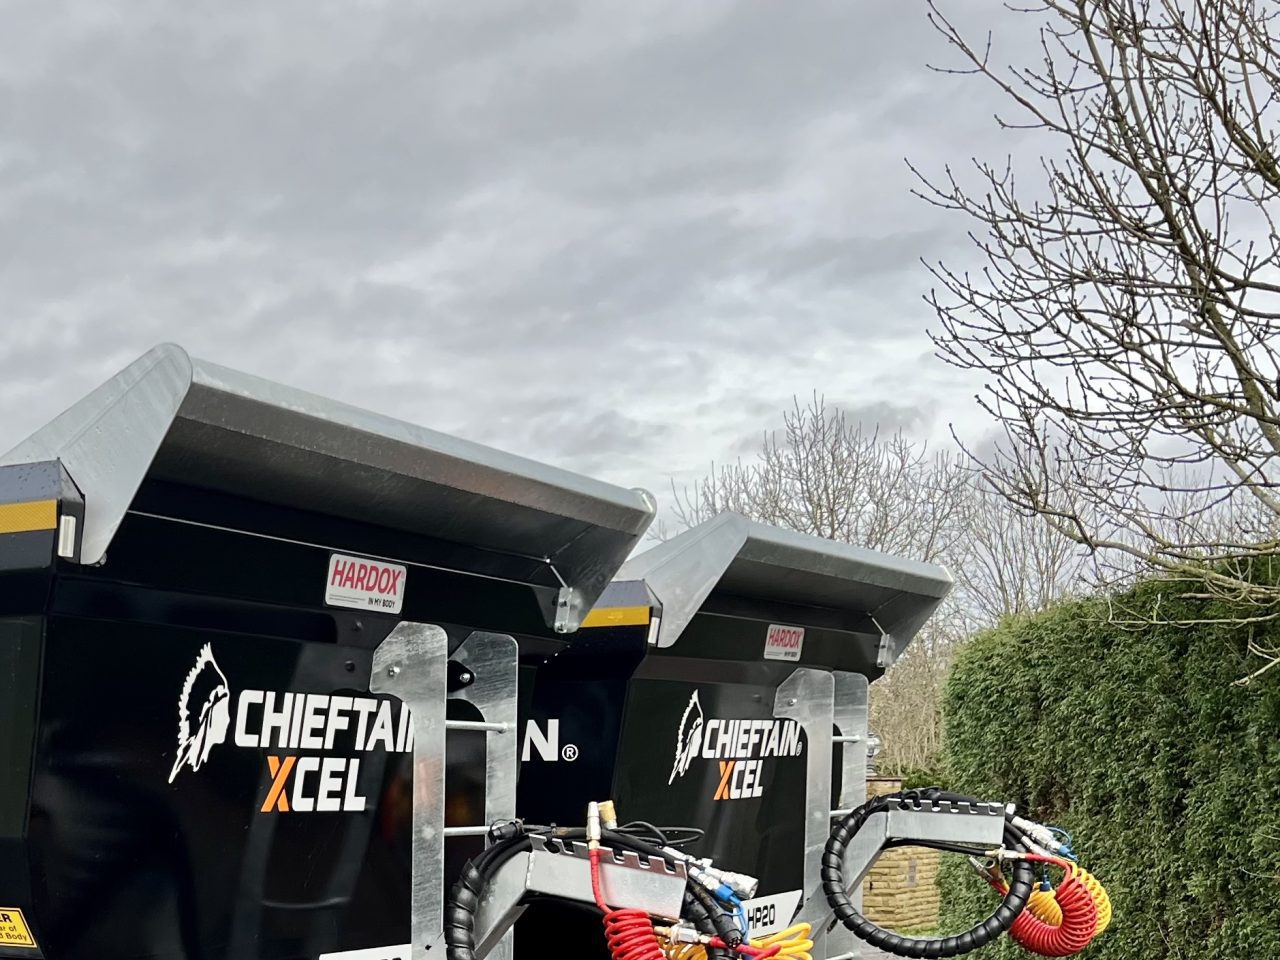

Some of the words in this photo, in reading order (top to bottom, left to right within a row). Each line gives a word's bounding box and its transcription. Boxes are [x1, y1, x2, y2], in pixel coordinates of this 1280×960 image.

[331, 560, 401, 595] HARDOX
[374, 598, 382, 607] MY
[382, 599, 396, 608] BODY
[260, 755, 367, 813] XCEL
[713, 760, 764, 800] XCEL
[747, 904, 776, 930] HP20
[6, 932, 27, 942] Body
